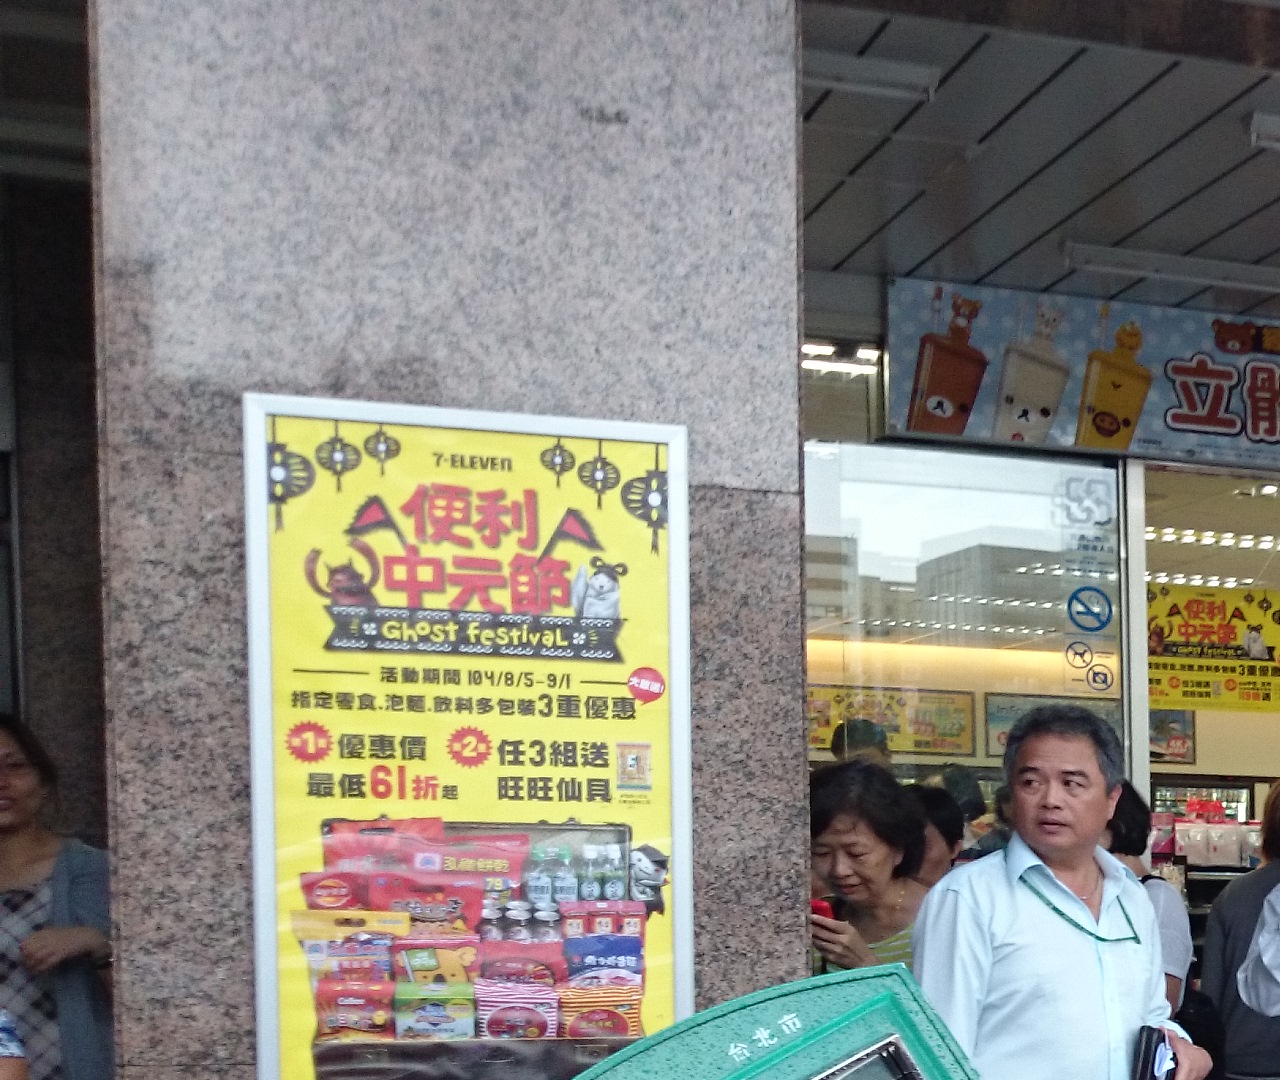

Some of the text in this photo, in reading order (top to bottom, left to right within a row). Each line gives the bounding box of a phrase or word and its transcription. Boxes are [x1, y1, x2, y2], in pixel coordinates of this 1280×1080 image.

[401, 482, 541, 549] 便利
[383, 545, 573, 616] 中元節
[380, 666, 462, 686] 活動期間
[337, 733, 428, 763] 優惠價
[497, 739, 611, 770] 任3組送
[496, 775, 613, 804] 旺旺仙貝
[728, 1012, 804, 1062] 台北市
